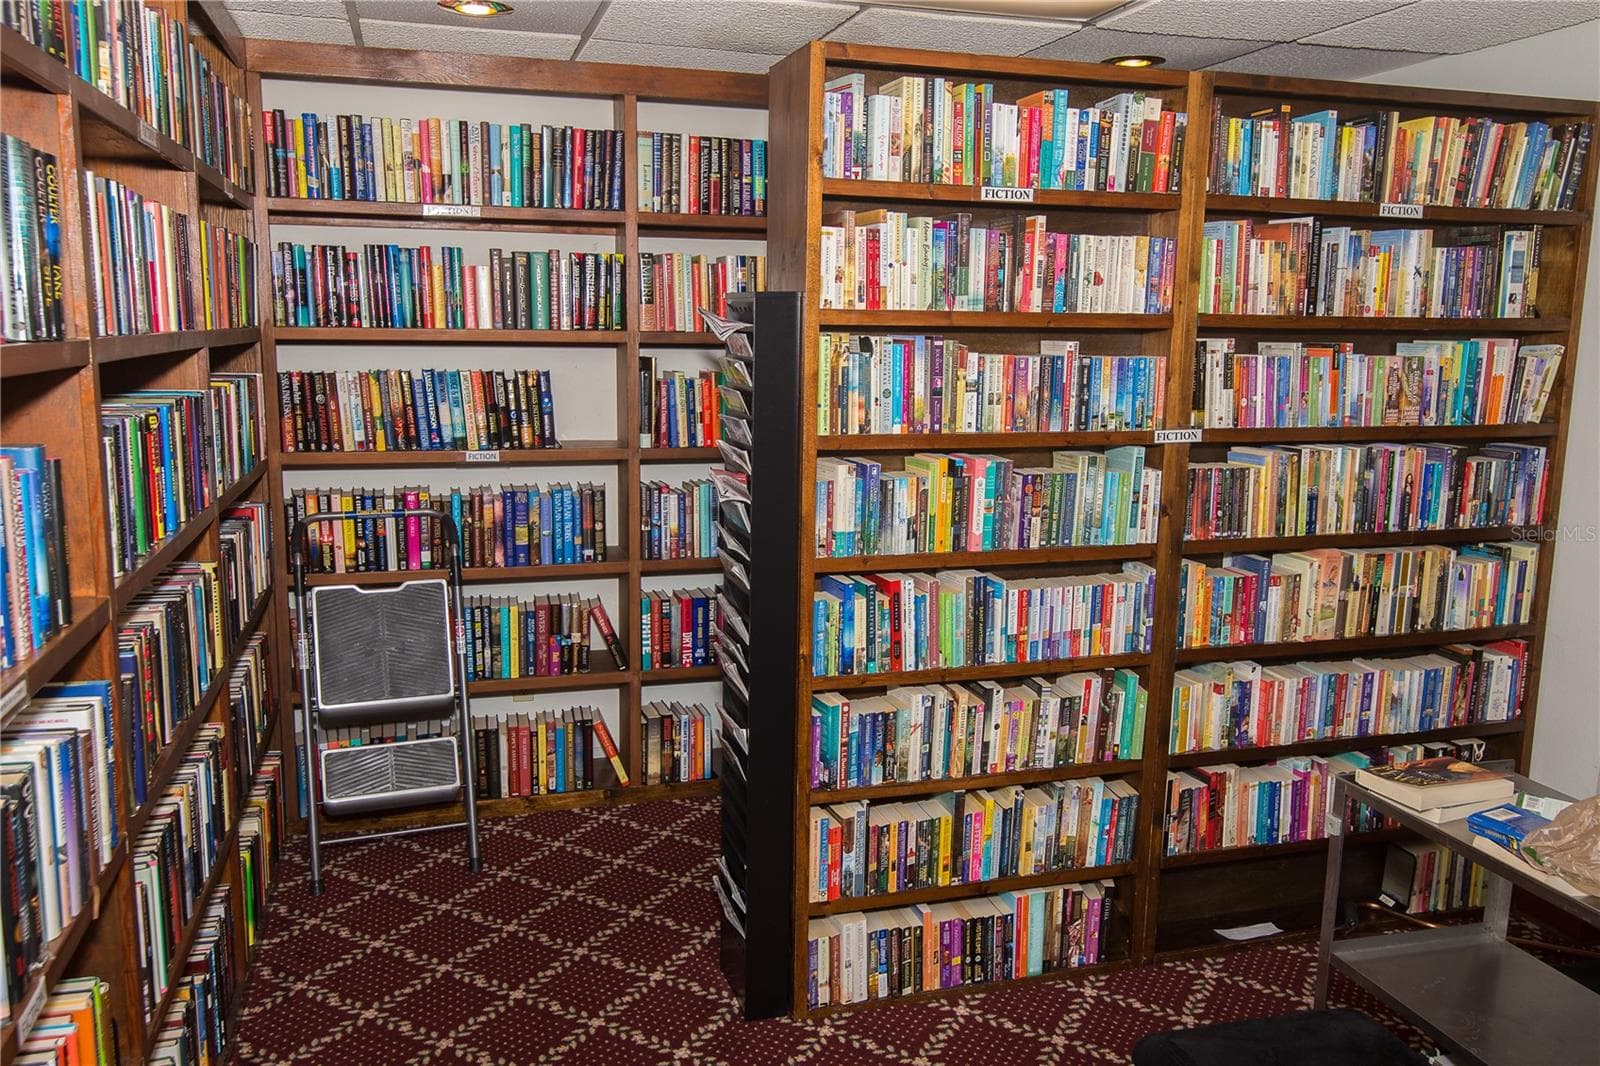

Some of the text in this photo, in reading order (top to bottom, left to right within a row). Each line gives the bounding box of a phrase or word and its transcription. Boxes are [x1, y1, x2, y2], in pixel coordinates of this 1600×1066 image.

[643, 164, 651, 191] London
[47, 164, 60, 224] COULTER
[984, 188, 1030, 200] FICTION
[1382, 206, 1420, 216] FICTION
[586, 256, 595, 284] BRUSH
[641, 258, 652, 301] EMPIRE
[280, 374, 289, 389] SARA
[282, 390, 292, 417] PARETSKY
[424, 372, 437, 429] JAMES PATTERSON
[1157, 431, 1198, 441] FICTION
[468, 452, 496, 460] FICTION
[642, 614, 651, 655] WHITE
[682, 632, 693, 664] DRY ICE
